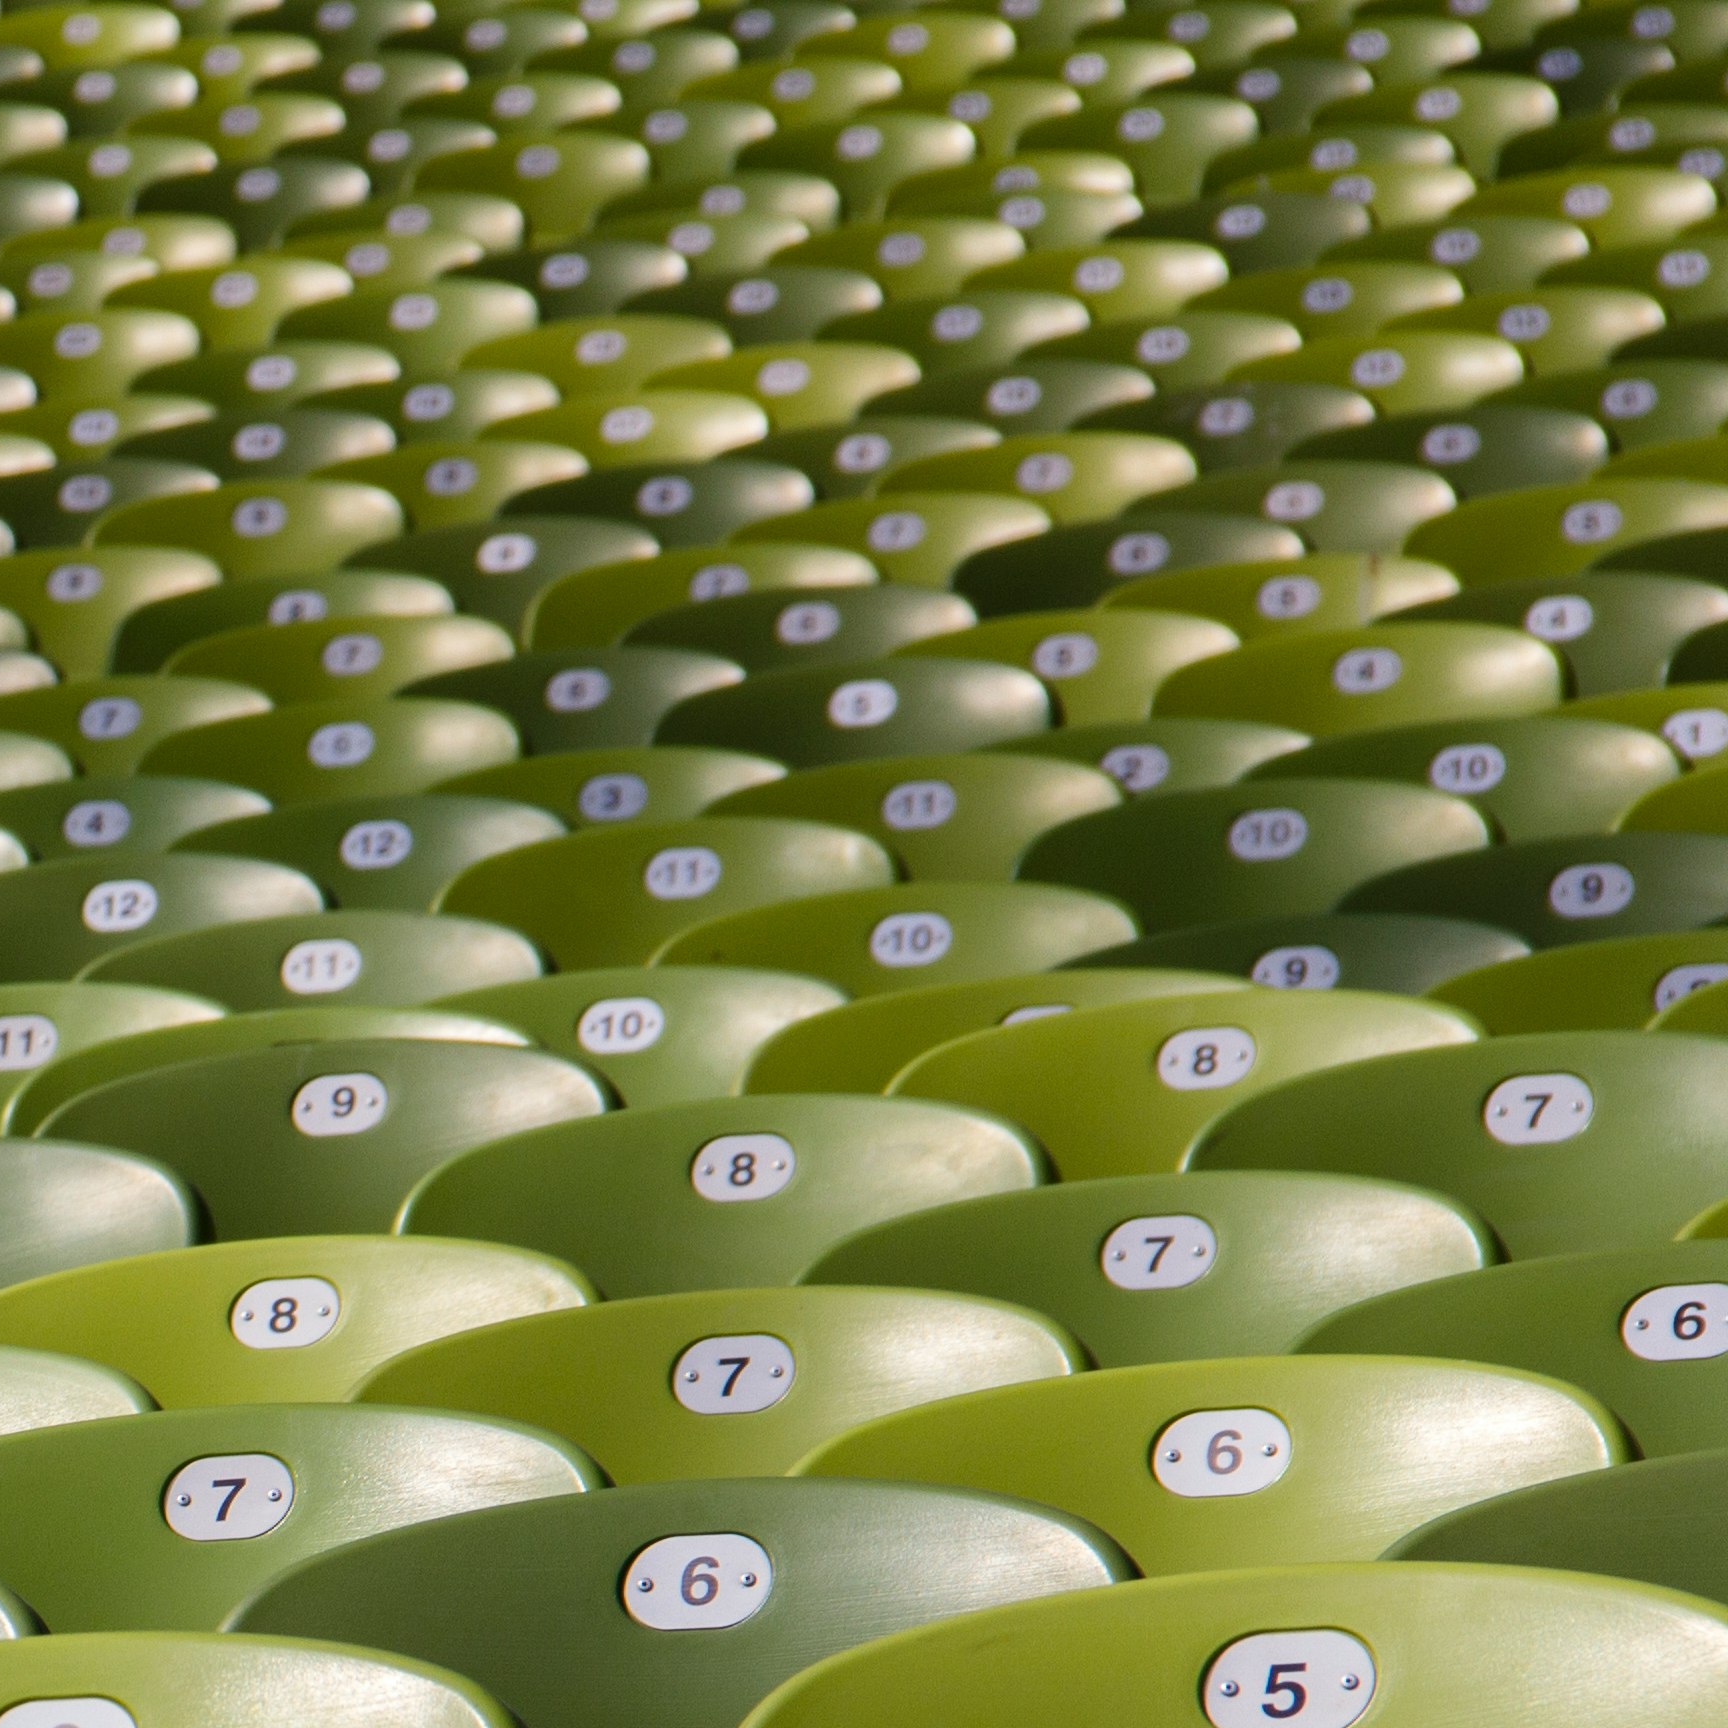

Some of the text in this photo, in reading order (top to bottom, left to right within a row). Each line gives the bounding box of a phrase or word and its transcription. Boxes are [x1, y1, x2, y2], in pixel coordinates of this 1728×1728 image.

[1249, 819, 1292, 847] 10
[664, 859, 700, 886] 11
[1580, 873, 1605, 904] 9
[103, 891, 140, 919] 12
[890, 924, 935, 954] 10
[302, 952, 339, 980] 11
[1282, 957, 1306, 987] 9
[599, 1010, 644, 1041] 10
[1191, 1043, 1218, 1077] 8
[331, 1085, 357, 1119] 9
[1524, 1093, 1553, 1130] 7
[728, 1151, 756, 1188] 8
[1144, 1235, 1174, 1274] 7
[268, 1296, 298, 1334] 8
[1672, 1300, 1706, 1341] 6
[717, 1356, 751, 1398] 7
[1205, 1429, 1243, 1476] 6
[211, 1477, 247, 1523] 7
[680, 1555, 720, 1607] 6
[1260, 1662, 1307, 1720] 5
